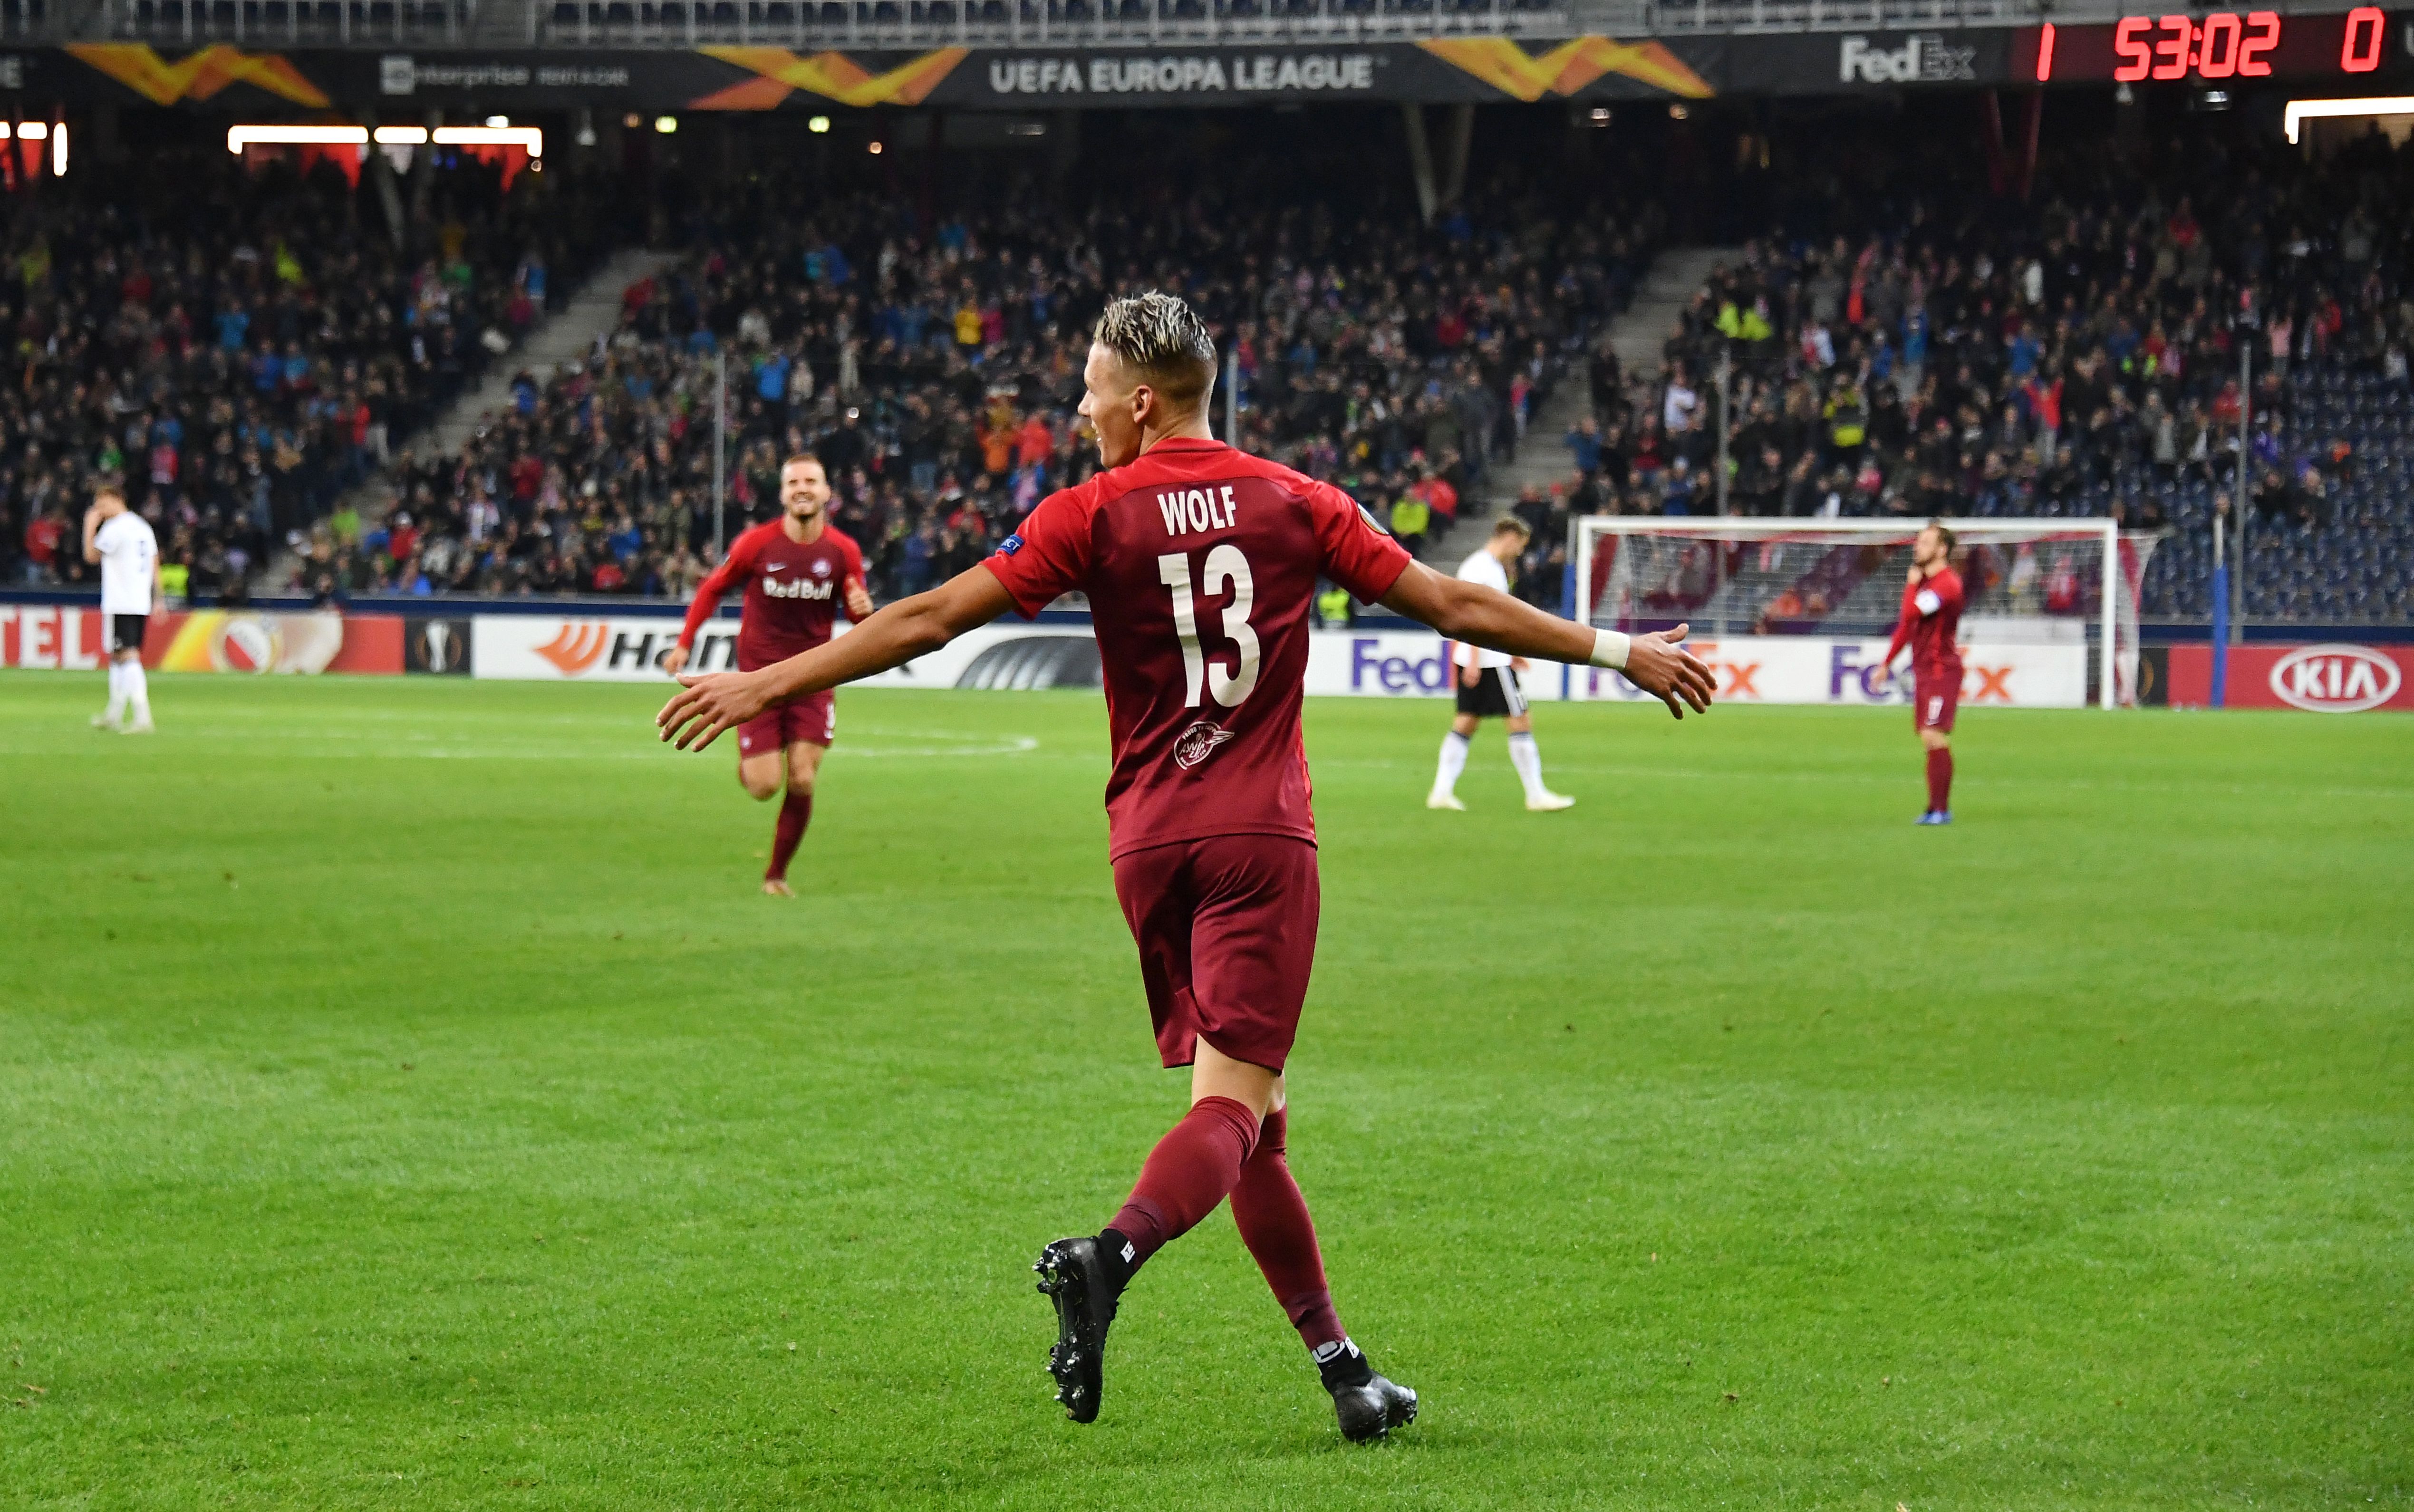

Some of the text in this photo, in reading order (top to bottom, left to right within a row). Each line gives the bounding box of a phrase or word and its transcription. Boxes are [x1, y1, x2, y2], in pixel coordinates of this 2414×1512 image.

[1840, 32, 1976, 83] FedEx
[2114, 11, 2280, 82] 53:02
[2341, 7, 2385, 73] 0
[989, 53, 1373, 93] UEFA EUROPA LEAGUE
[1157, 486, 1236, 537] WOLF
[1158, 544, 1261, 708] 13
[2292, 657, 2378, 699] KIA
